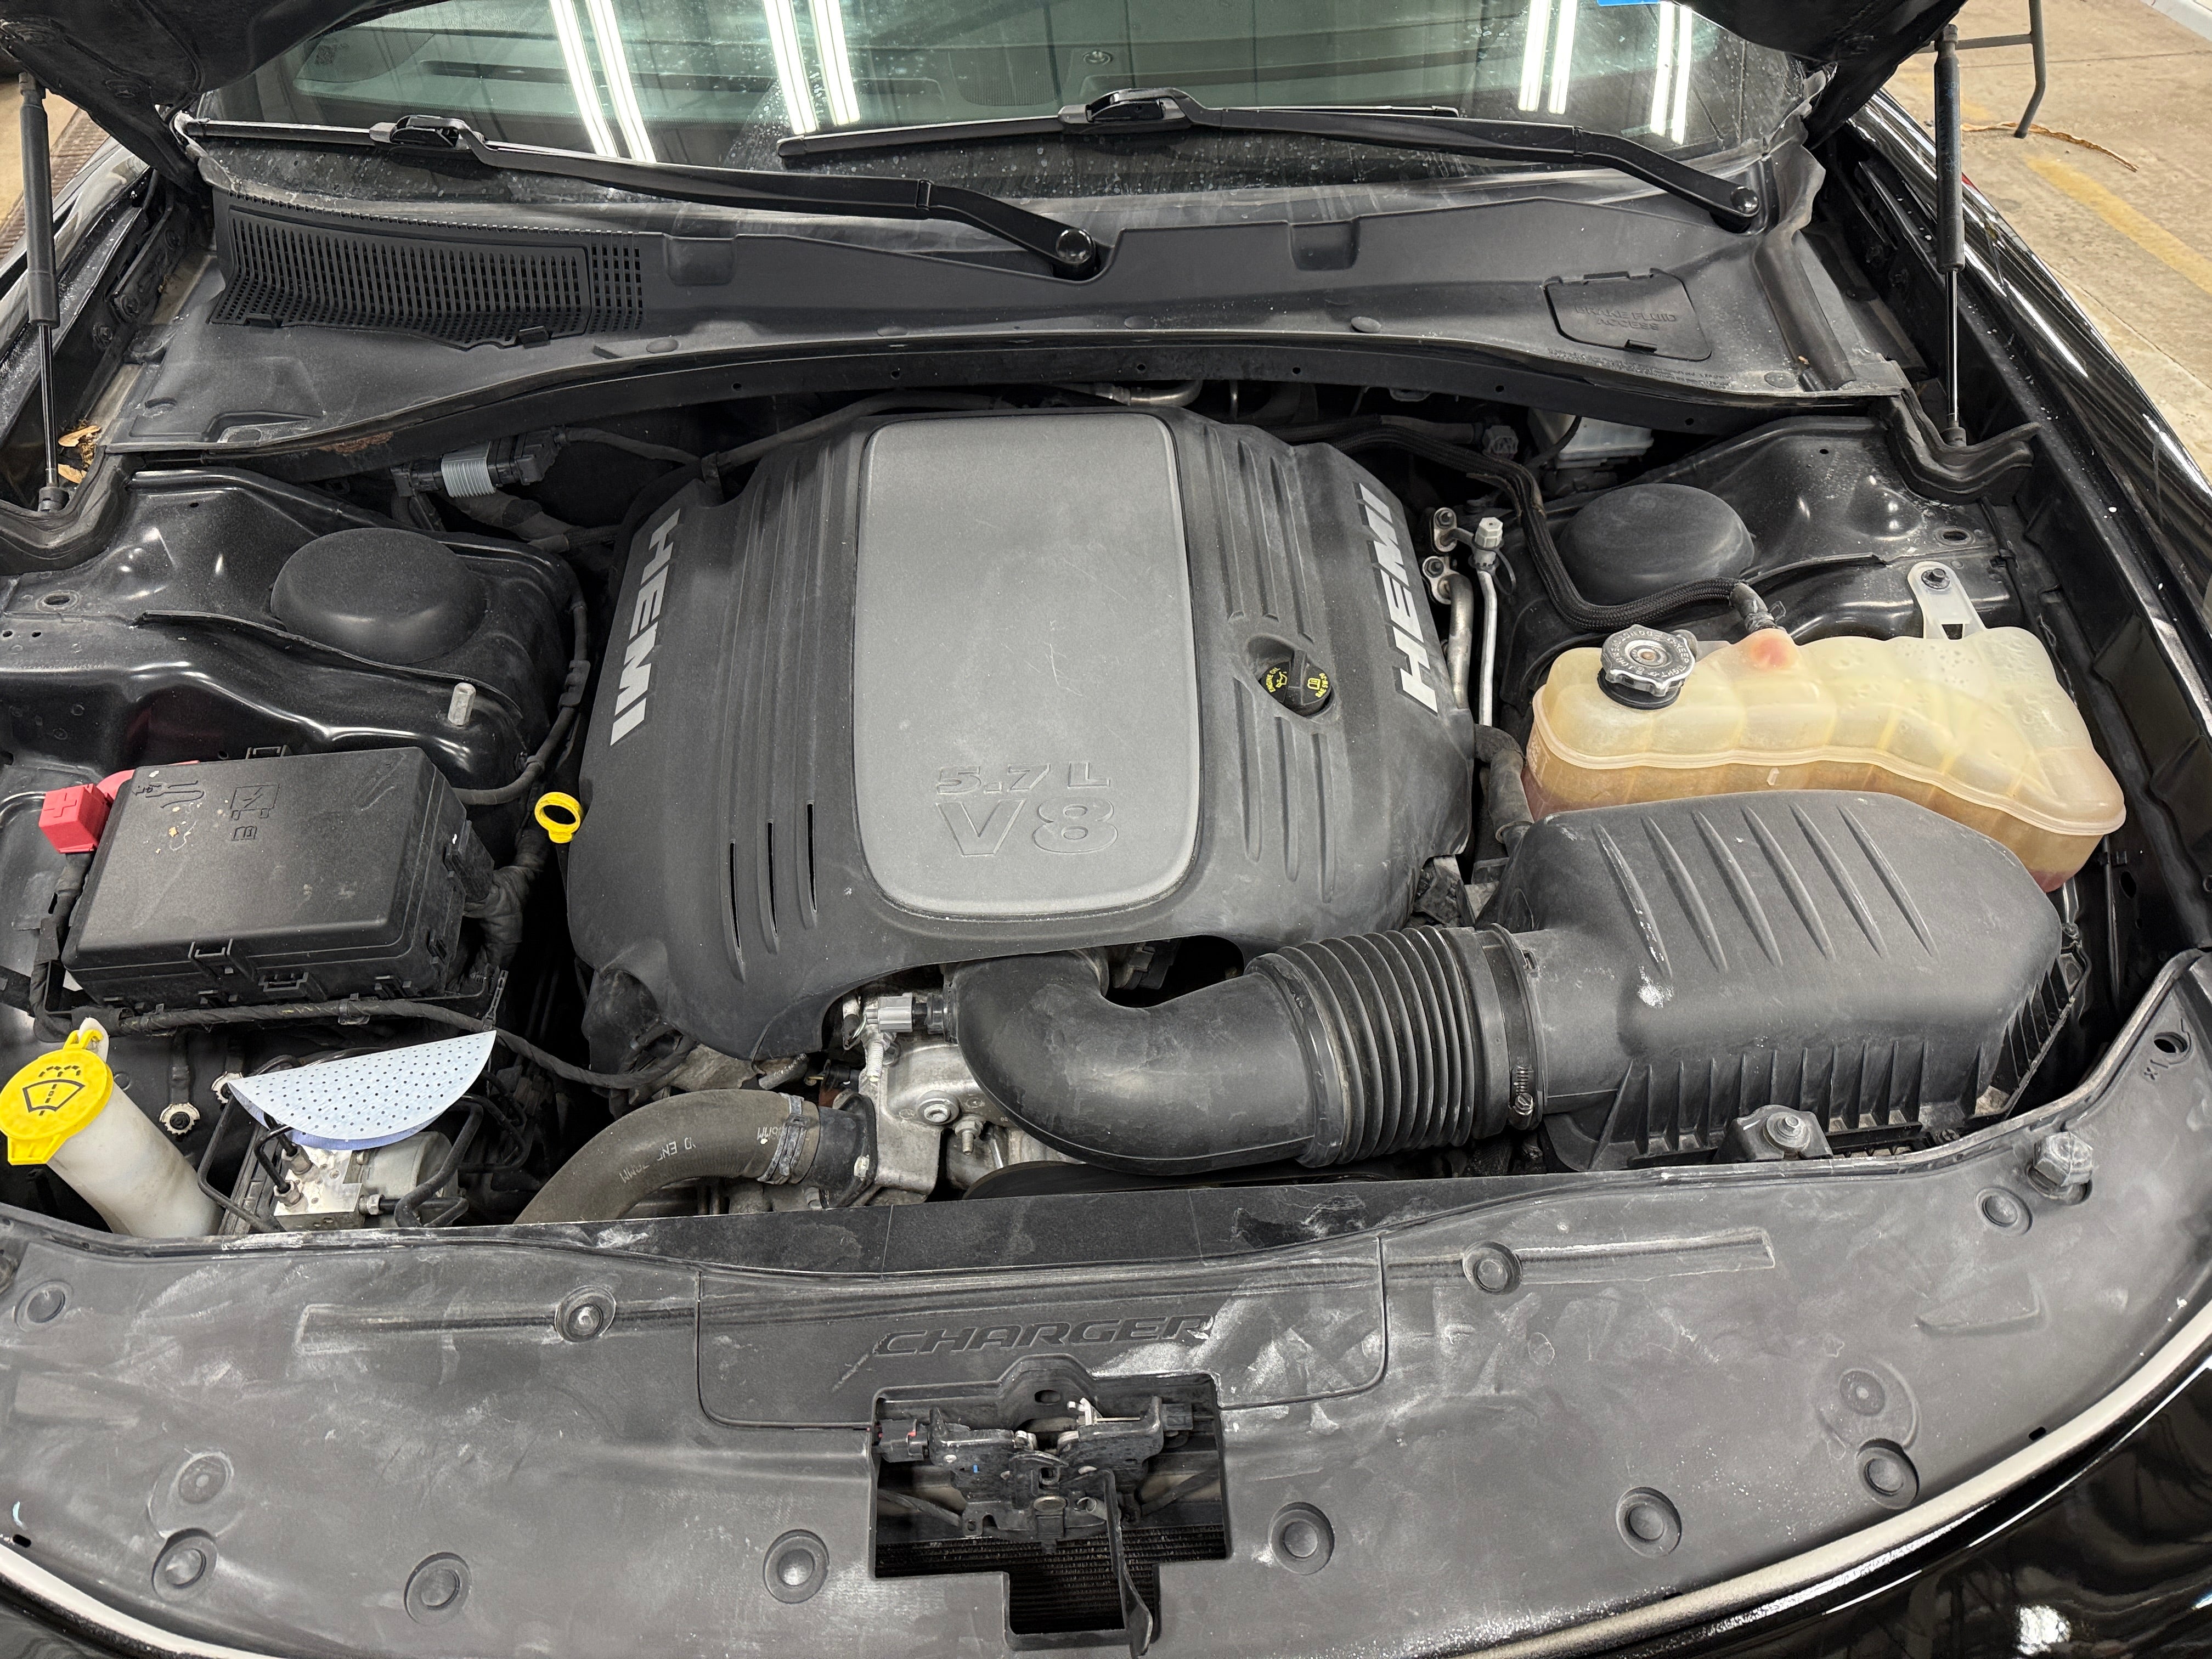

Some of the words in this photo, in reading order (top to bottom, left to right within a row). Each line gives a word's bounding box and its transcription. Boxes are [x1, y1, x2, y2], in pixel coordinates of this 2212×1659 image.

[1575, 305, 1629, 319] BRAKE
[1632, 312, 1677, 323] FLUID
[1598, 318, 1659, 331] ACCESS
[1358, 483, 1438, 714] HEMI
[610, 508, 681, 746] HEMI
[1266, 674, 1276, 693] ENGINE
[1315, 687, 1327, 698] SAE
[936, 764, 1051, 794] 5.7
[935, 795, 1119, 857] V8
[872, 1313, 1214, 1355] CHARGER
